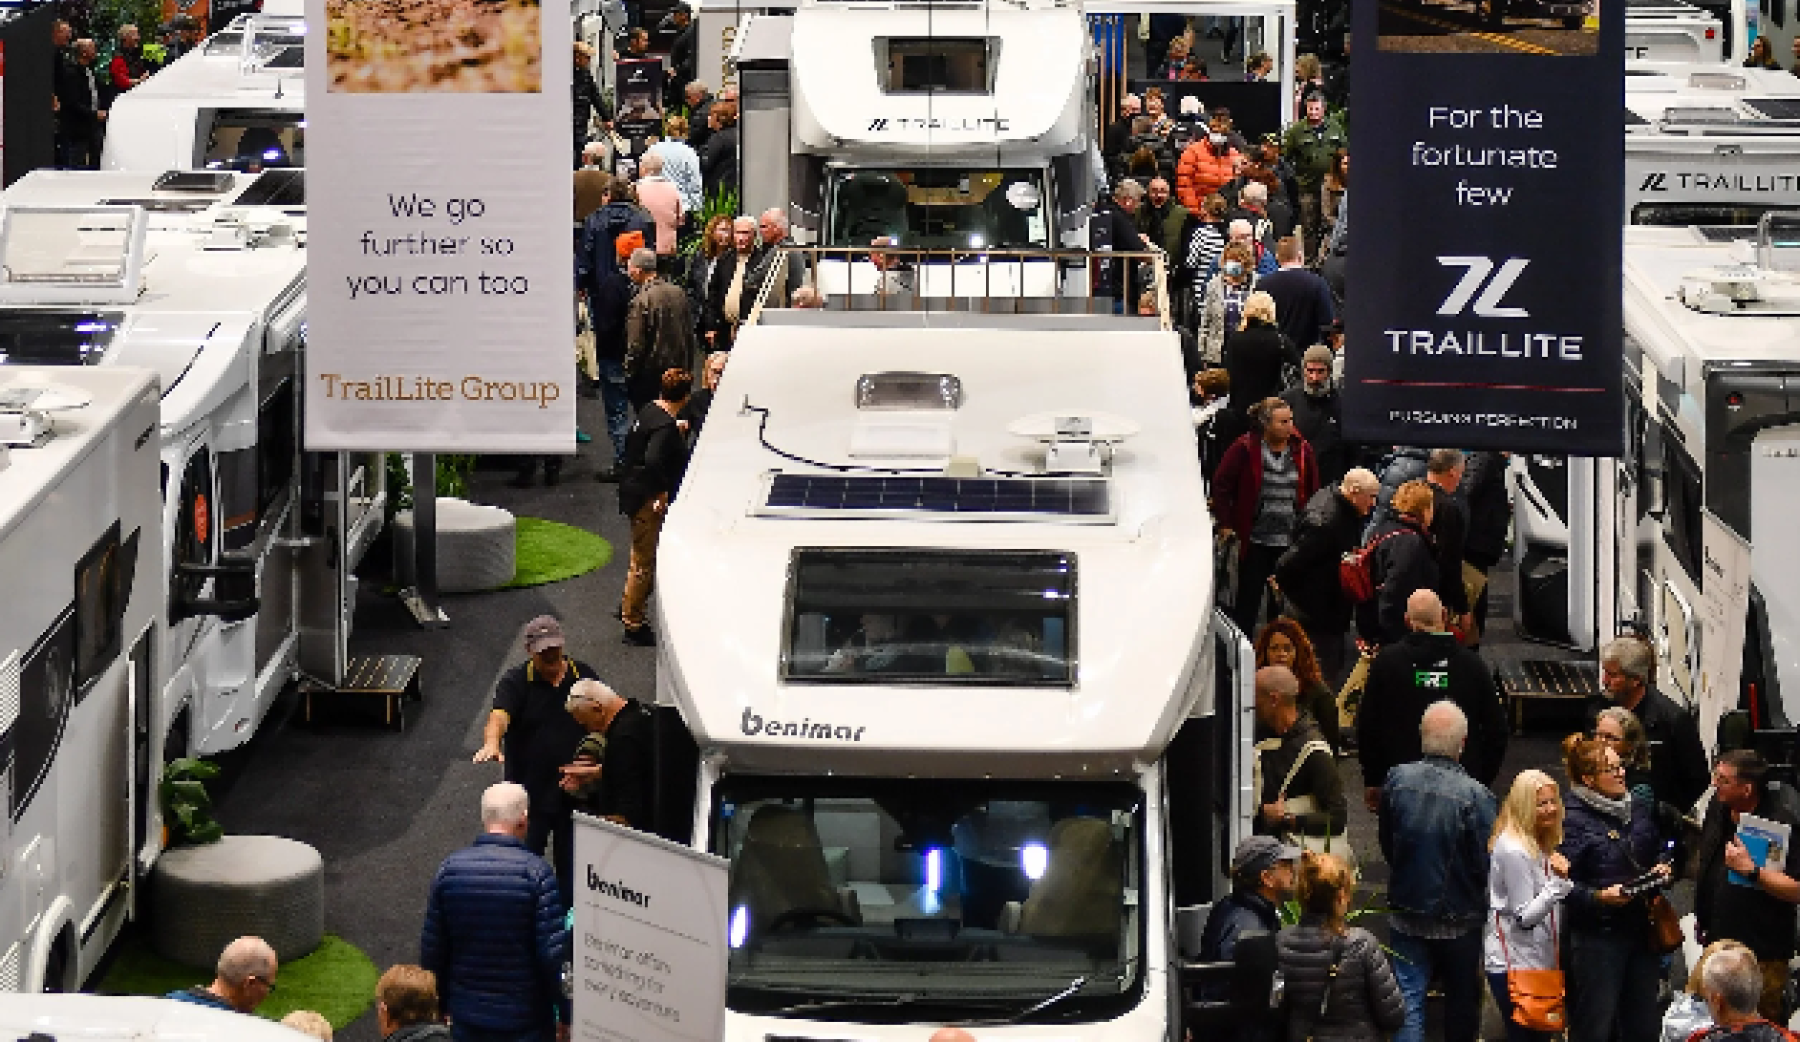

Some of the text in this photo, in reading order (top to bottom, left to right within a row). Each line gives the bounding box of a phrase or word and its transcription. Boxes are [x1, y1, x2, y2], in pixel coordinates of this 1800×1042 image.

[1429, 104, 1544, 128] For the
[1412, 141, 1559, 168] fortunate
[1455, 179, 1513, 206] few
[1676, 172, 1800, 191] TRAILLIT
[387, 193, 485, 225] We go
[360, 230, 514, 256] further so
[346, 271, 529, 300] you can too
[1384, 328, 1583, 360] TRAILLITE
[319, 373, 560, 409] TrailLite Group
[740, 706, 866, 742] benimar
[587, 863, 651, 909] benimar
